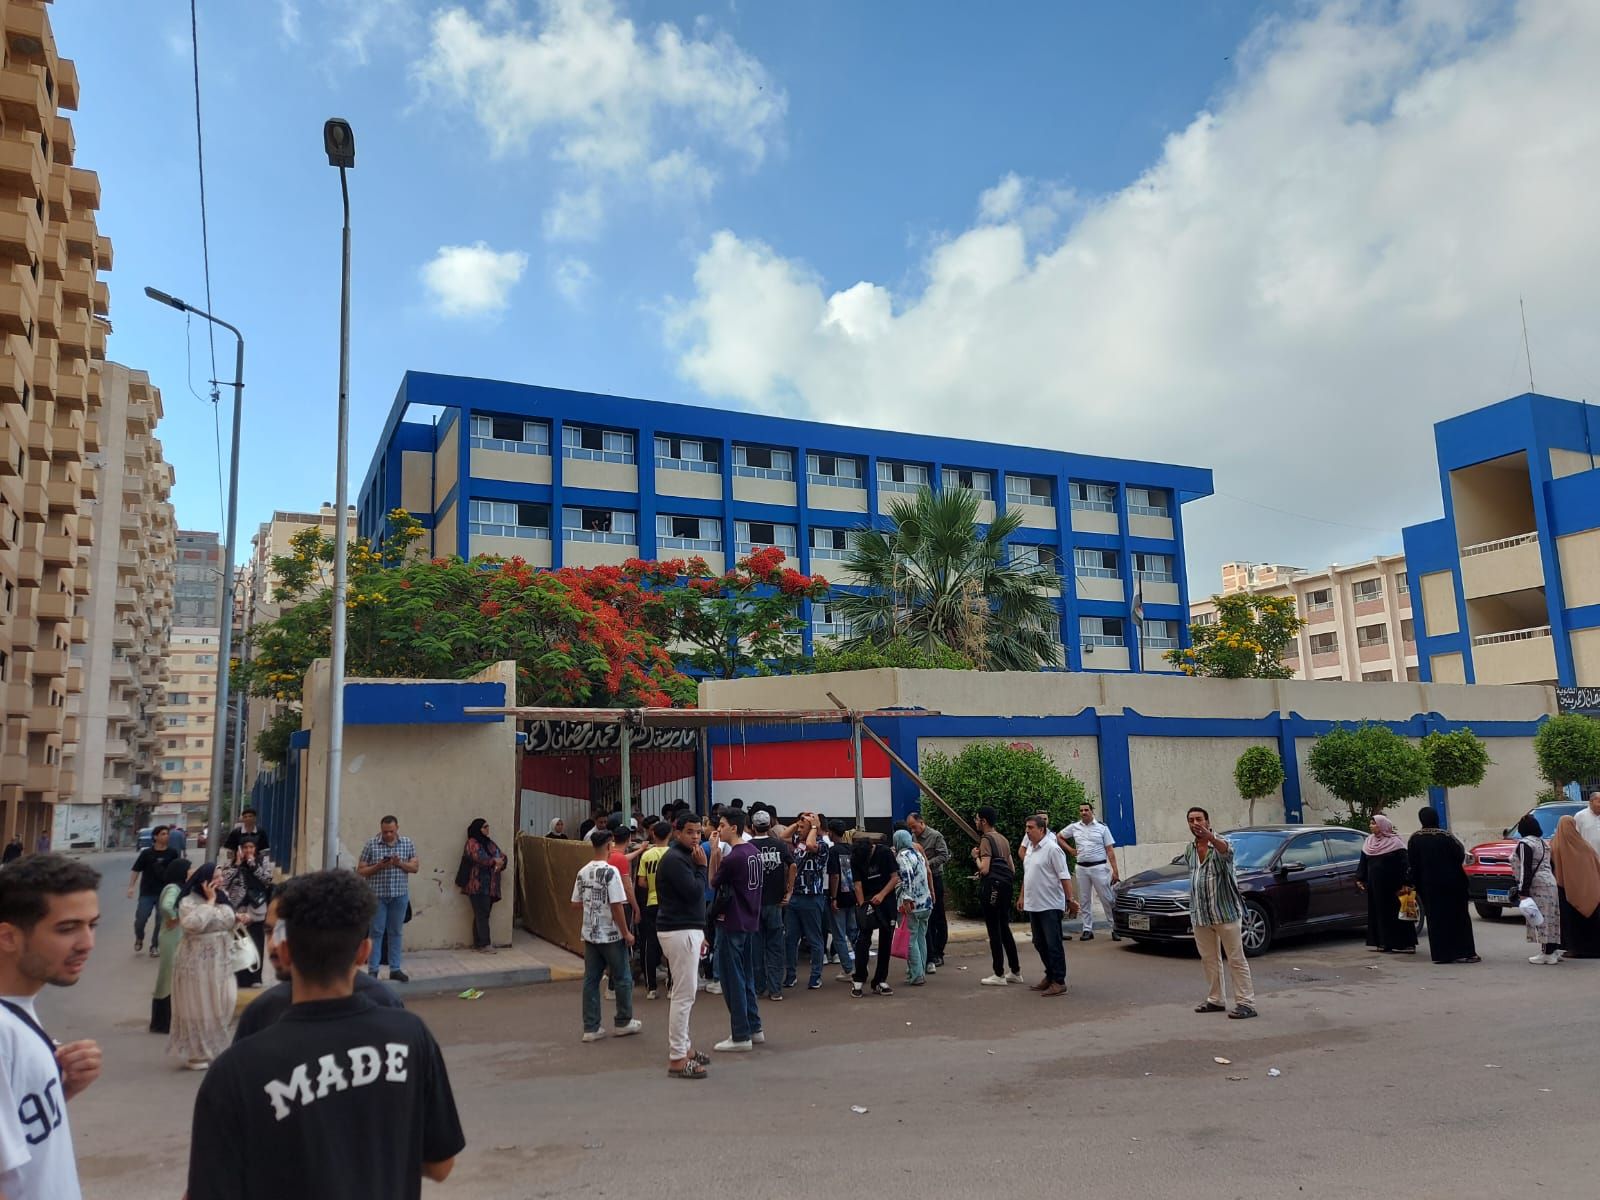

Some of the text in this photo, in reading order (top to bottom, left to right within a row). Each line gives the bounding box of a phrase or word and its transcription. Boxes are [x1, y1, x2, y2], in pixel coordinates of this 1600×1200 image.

[551, 720, 594, 750] رمضان
[587, 723, 616, 748] محمد
[654, 727, 696, 748] مدرسة
[263, 1042, 409, 1121] MADE
